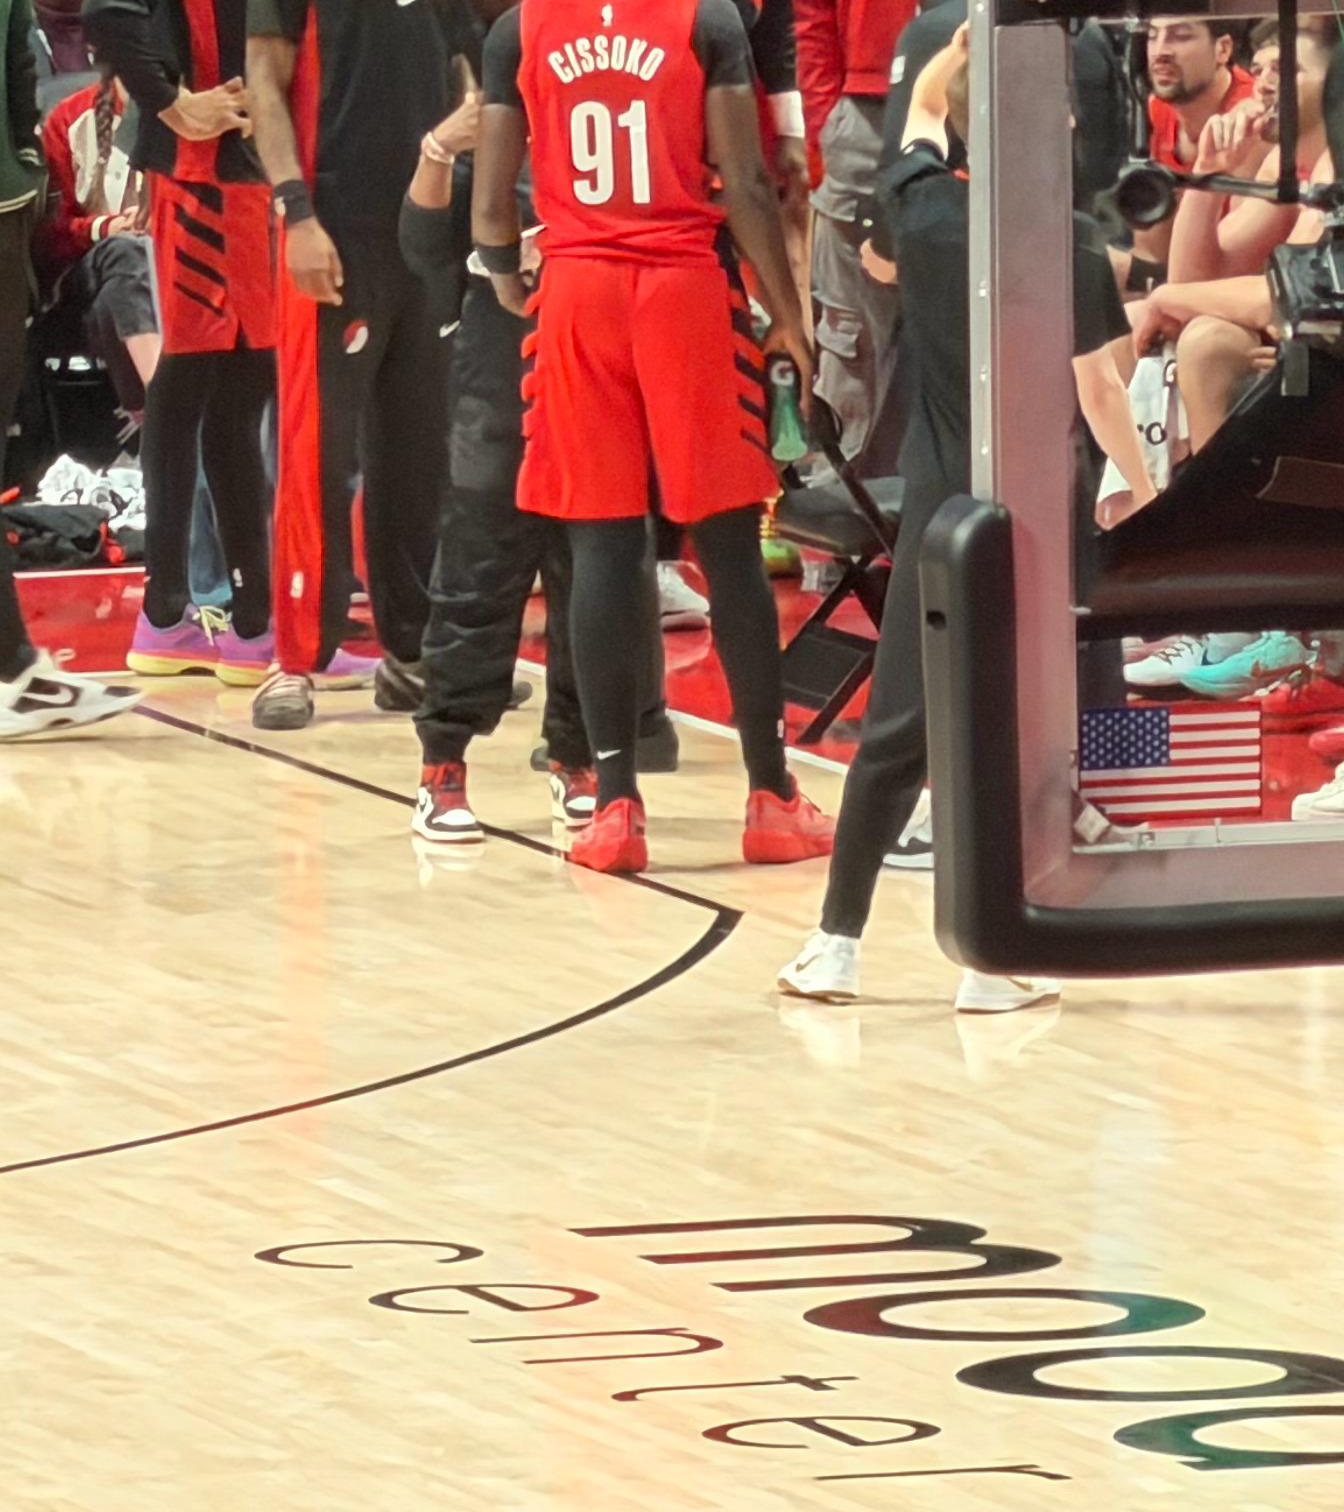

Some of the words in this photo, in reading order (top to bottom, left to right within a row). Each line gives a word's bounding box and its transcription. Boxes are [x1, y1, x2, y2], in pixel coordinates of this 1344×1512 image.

[548, 34, 665, 84] CISSOKO
[570, 99, 651, 205] 91
[770, 360, 795, 387] G
[253, 1238, 1072, 1480] center
